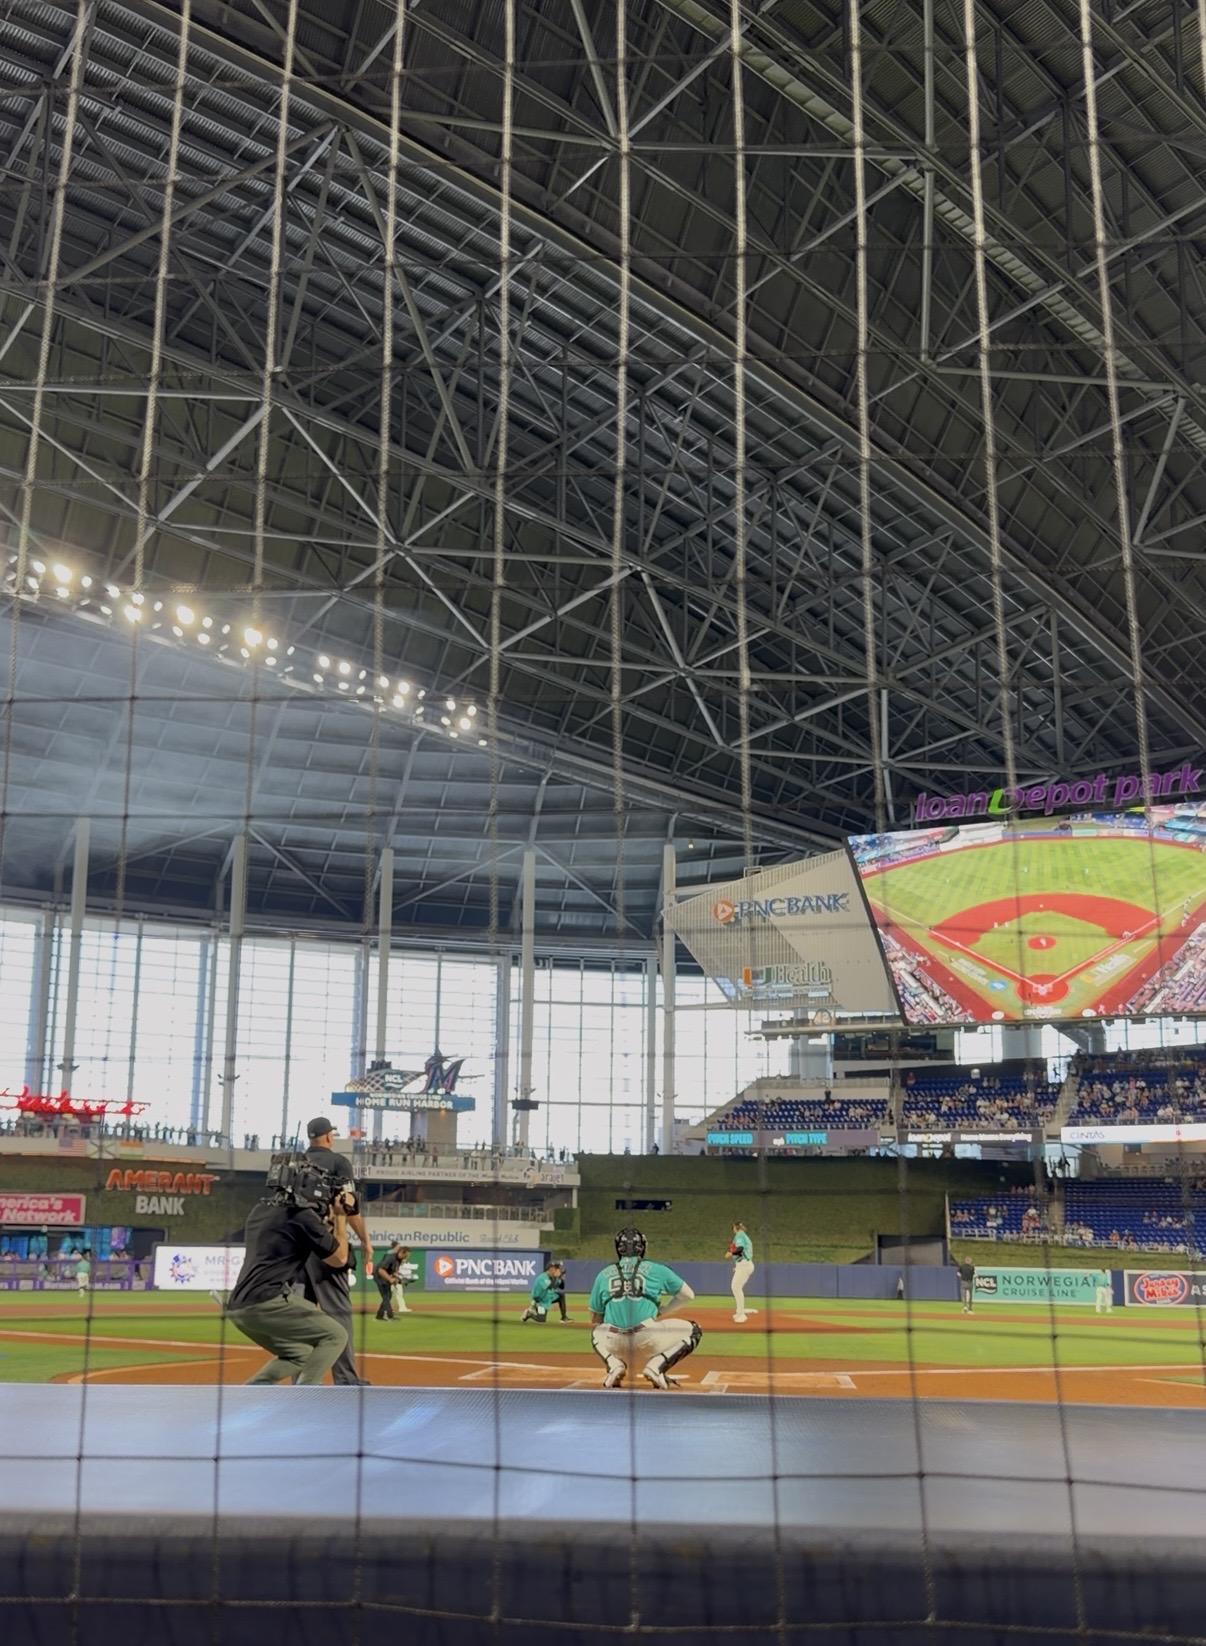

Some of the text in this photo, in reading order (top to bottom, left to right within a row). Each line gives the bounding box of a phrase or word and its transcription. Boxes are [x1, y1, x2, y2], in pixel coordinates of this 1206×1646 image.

[915, 763, 1201, 822] loanDepot park
[356, 1097, 453, 1110] HOME RUN HARBOR
[105, 1168, 215, 1196] AMERANT
[135, 1195, 186, 1216] BANK
[2, 1208, 77, 1223] Network
[974, 1276, 997, 1288] NCL
[1002, 1287, 1076, 1298] CRUISE LINE
